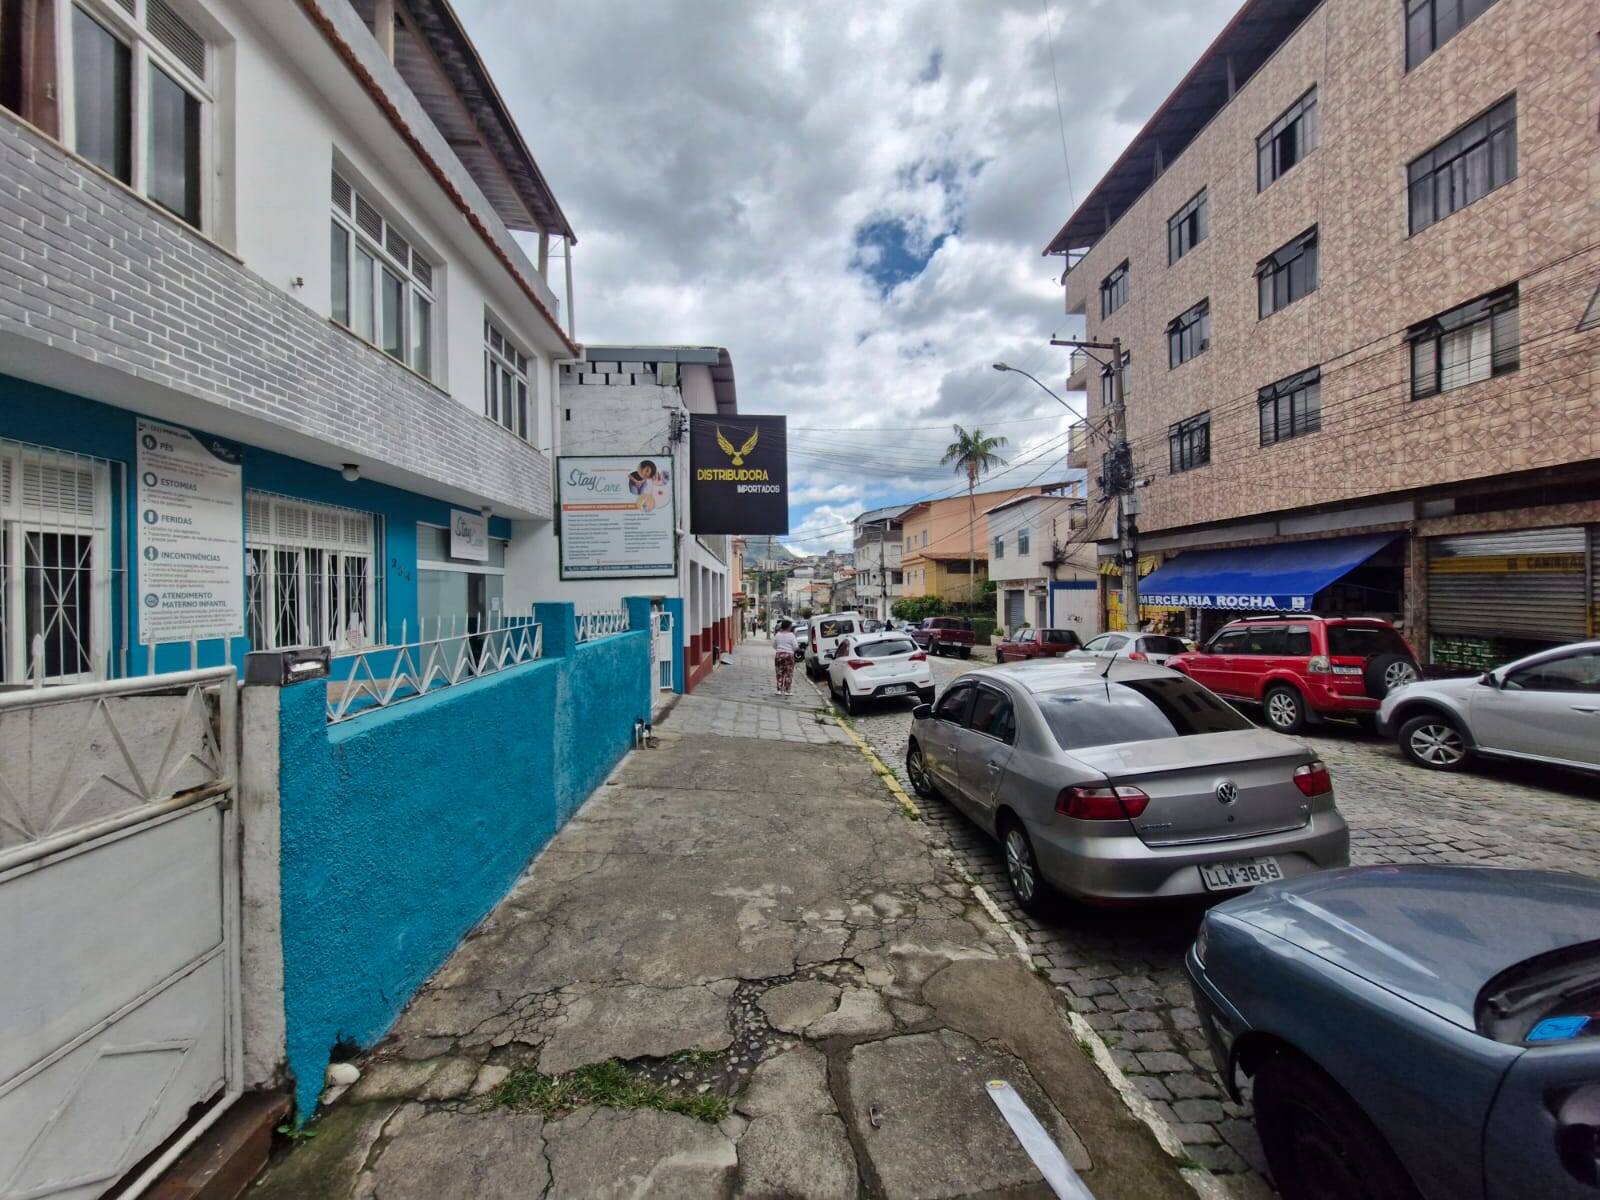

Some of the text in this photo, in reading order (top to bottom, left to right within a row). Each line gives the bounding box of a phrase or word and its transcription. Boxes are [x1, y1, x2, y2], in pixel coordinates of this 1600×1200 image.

[160, 442, 174, 452] PÉS
[567, 468, 622, 493] Stay Care
[697, 469, 769, 481] DISTRIBUIDORA
[161, 478, 197, 491] ESTOMIAS
[737, 484, 780, 494] IMPORTADOS
[161, 514, 193, 525] FERIDAS
[161, 551, 221, 562] INCONTINÊNCIAS
[162, 592, 213, 600] ATENDIMENTO
[1139, 595, 1276, 608] MERCEARIA ROCHA
[162, 600, 226, 609] MATERNO INFANTIL
